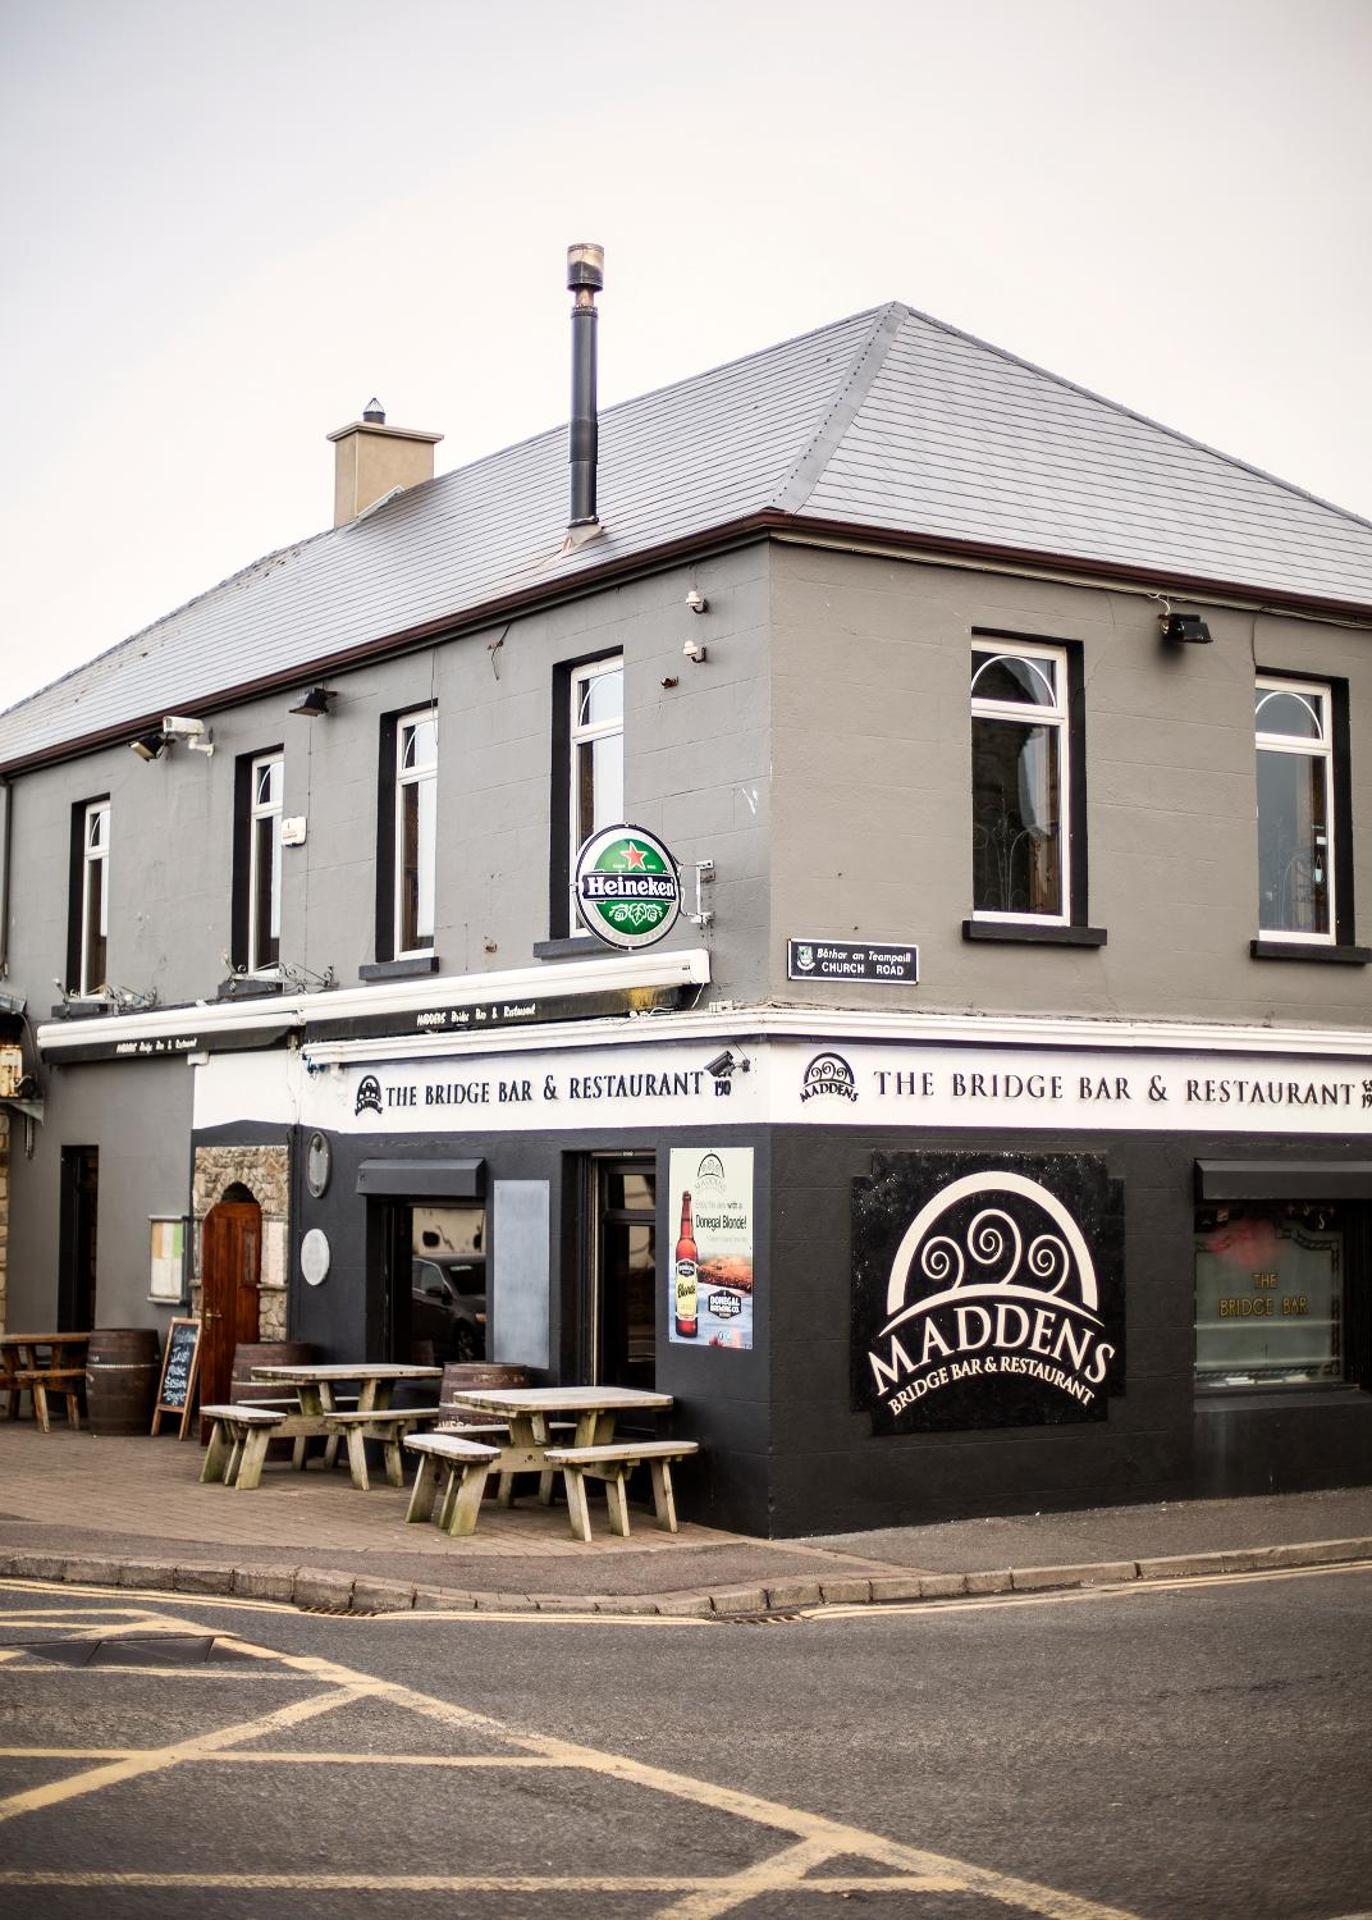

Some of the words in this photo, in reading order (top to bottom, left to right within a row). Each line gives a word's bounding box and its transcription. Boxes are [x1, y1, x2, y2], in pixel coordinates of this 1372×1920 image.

[587, 876, 674, 896] Heineken
[852, 952, 864, 960] an
[868, 951, 911, 965] Teampaill
[822, 962, 864, 974] CHURCH
[876, 965, 904, 976] ROAD
[386, 1086, 417, 1106] THE
[425, 1082, 490, 1105] BRIDGE
[498, 1080, 532, 1103] BAR
[543, 1075, 559, 1100] &
[569, 1071, 704, 1099] RESTAURANT
[800, 1083, 859, 1102] MADDENS
[873, 1071, 934, 1096] THE
[952, 1073, 1063, 1099] BRIDGE
[1079, 1076, 1132, 1100] BAR
[1148, 1075, 1167, 1101] &
[1186, 1079, 1355, 1105] RESTAURANT
[695, 1214, 721, 1232] Donegal
[1253, 1273, 1279, 1289] THE
[710, 1296, 740, 1306] DONEGAL
[1218, 1298, 1274, 1317] BRIDGE
[1282, 1296, 1309, 1315] BAR
[868, 1303, 1116, 1396] MADDENS
[888, 1366, 950, 1416] BRIDGE
[950, 1358, 982, 1380] BAR
[984, 1356, 997, 1373] &
[1000, 1356, 1095, 1407] RESTAURANT
